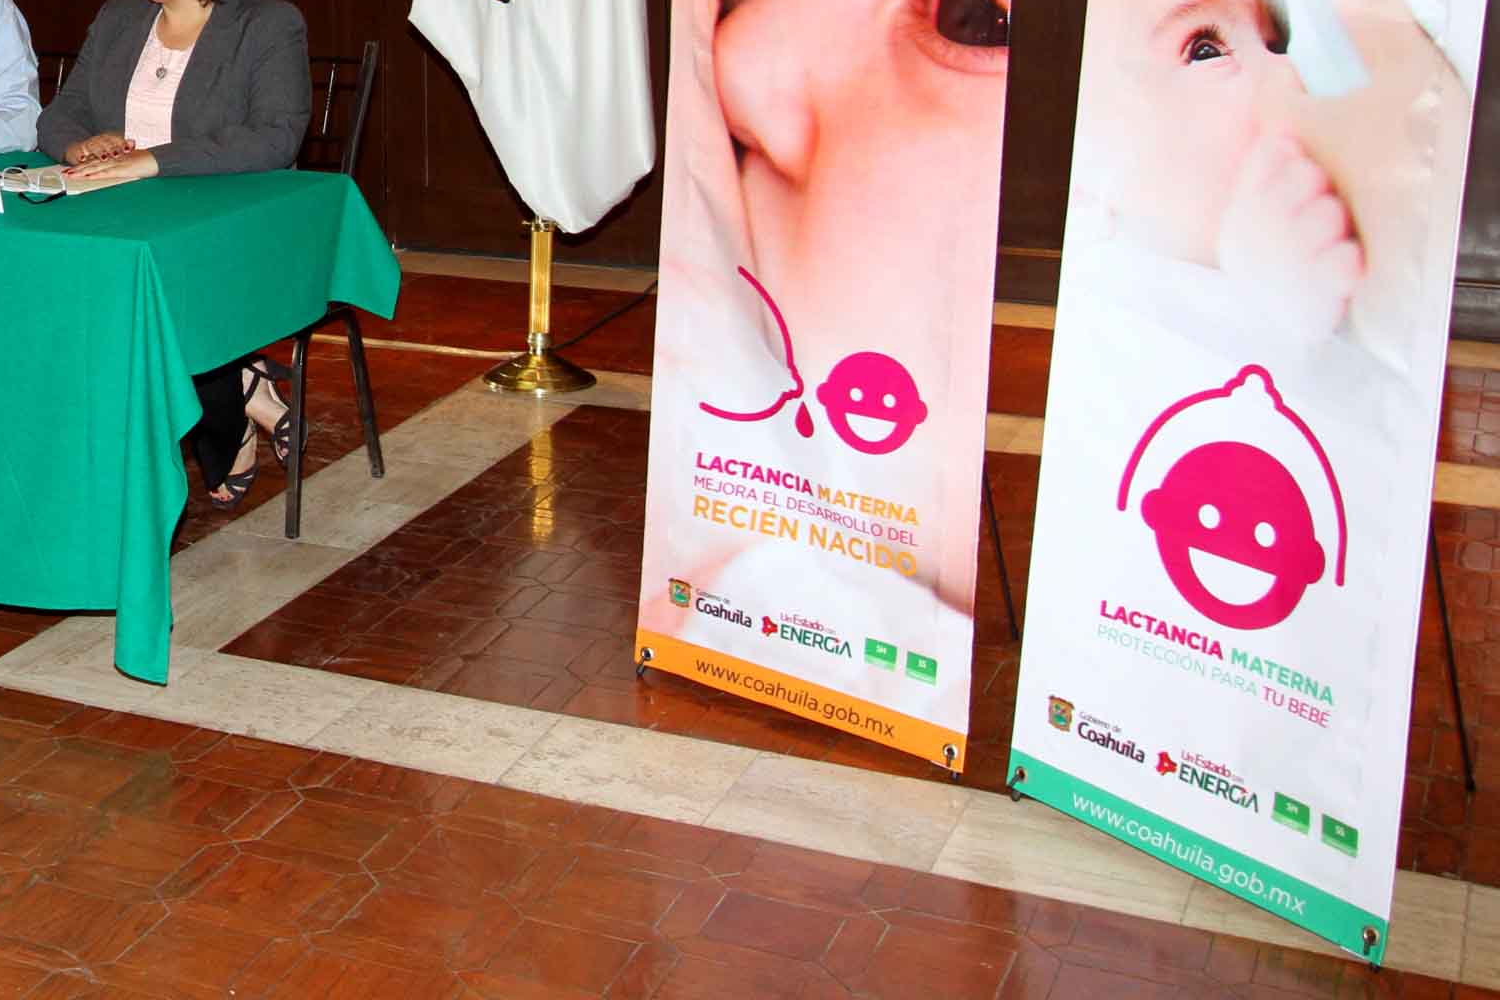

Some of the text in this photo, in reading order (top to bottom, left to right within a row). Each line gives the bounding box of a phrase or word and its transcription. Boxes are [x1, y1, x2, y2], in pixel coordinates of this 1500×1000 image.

[693, 475, 918, 547] MEJORA EL DESARROLLO DEL
[695, 451, 919, 526] LACTANCIA MATERNA
[692, 494, 917, 578] RECIÉN NACIDO
[695, 597, 752, 629] Coahuila
[792, 614, 824, 632] Estado
[1097, 624, 1206, 678] PROTECCIÓN
[1211, 666, 1258, 696] PARA
[1262, 685, 1284, 707] TU
[1100, 599, 1334, 706] LACTANCIA MATERNA
[695, 657, 896, 739] www.coahuila.gob.mx
[1077, 721, 1146, 764] Coahuila
[1194, 753, 1232, 778] Estado
[1071, 791, 1307, 916] www.coahuila.gob.mx
